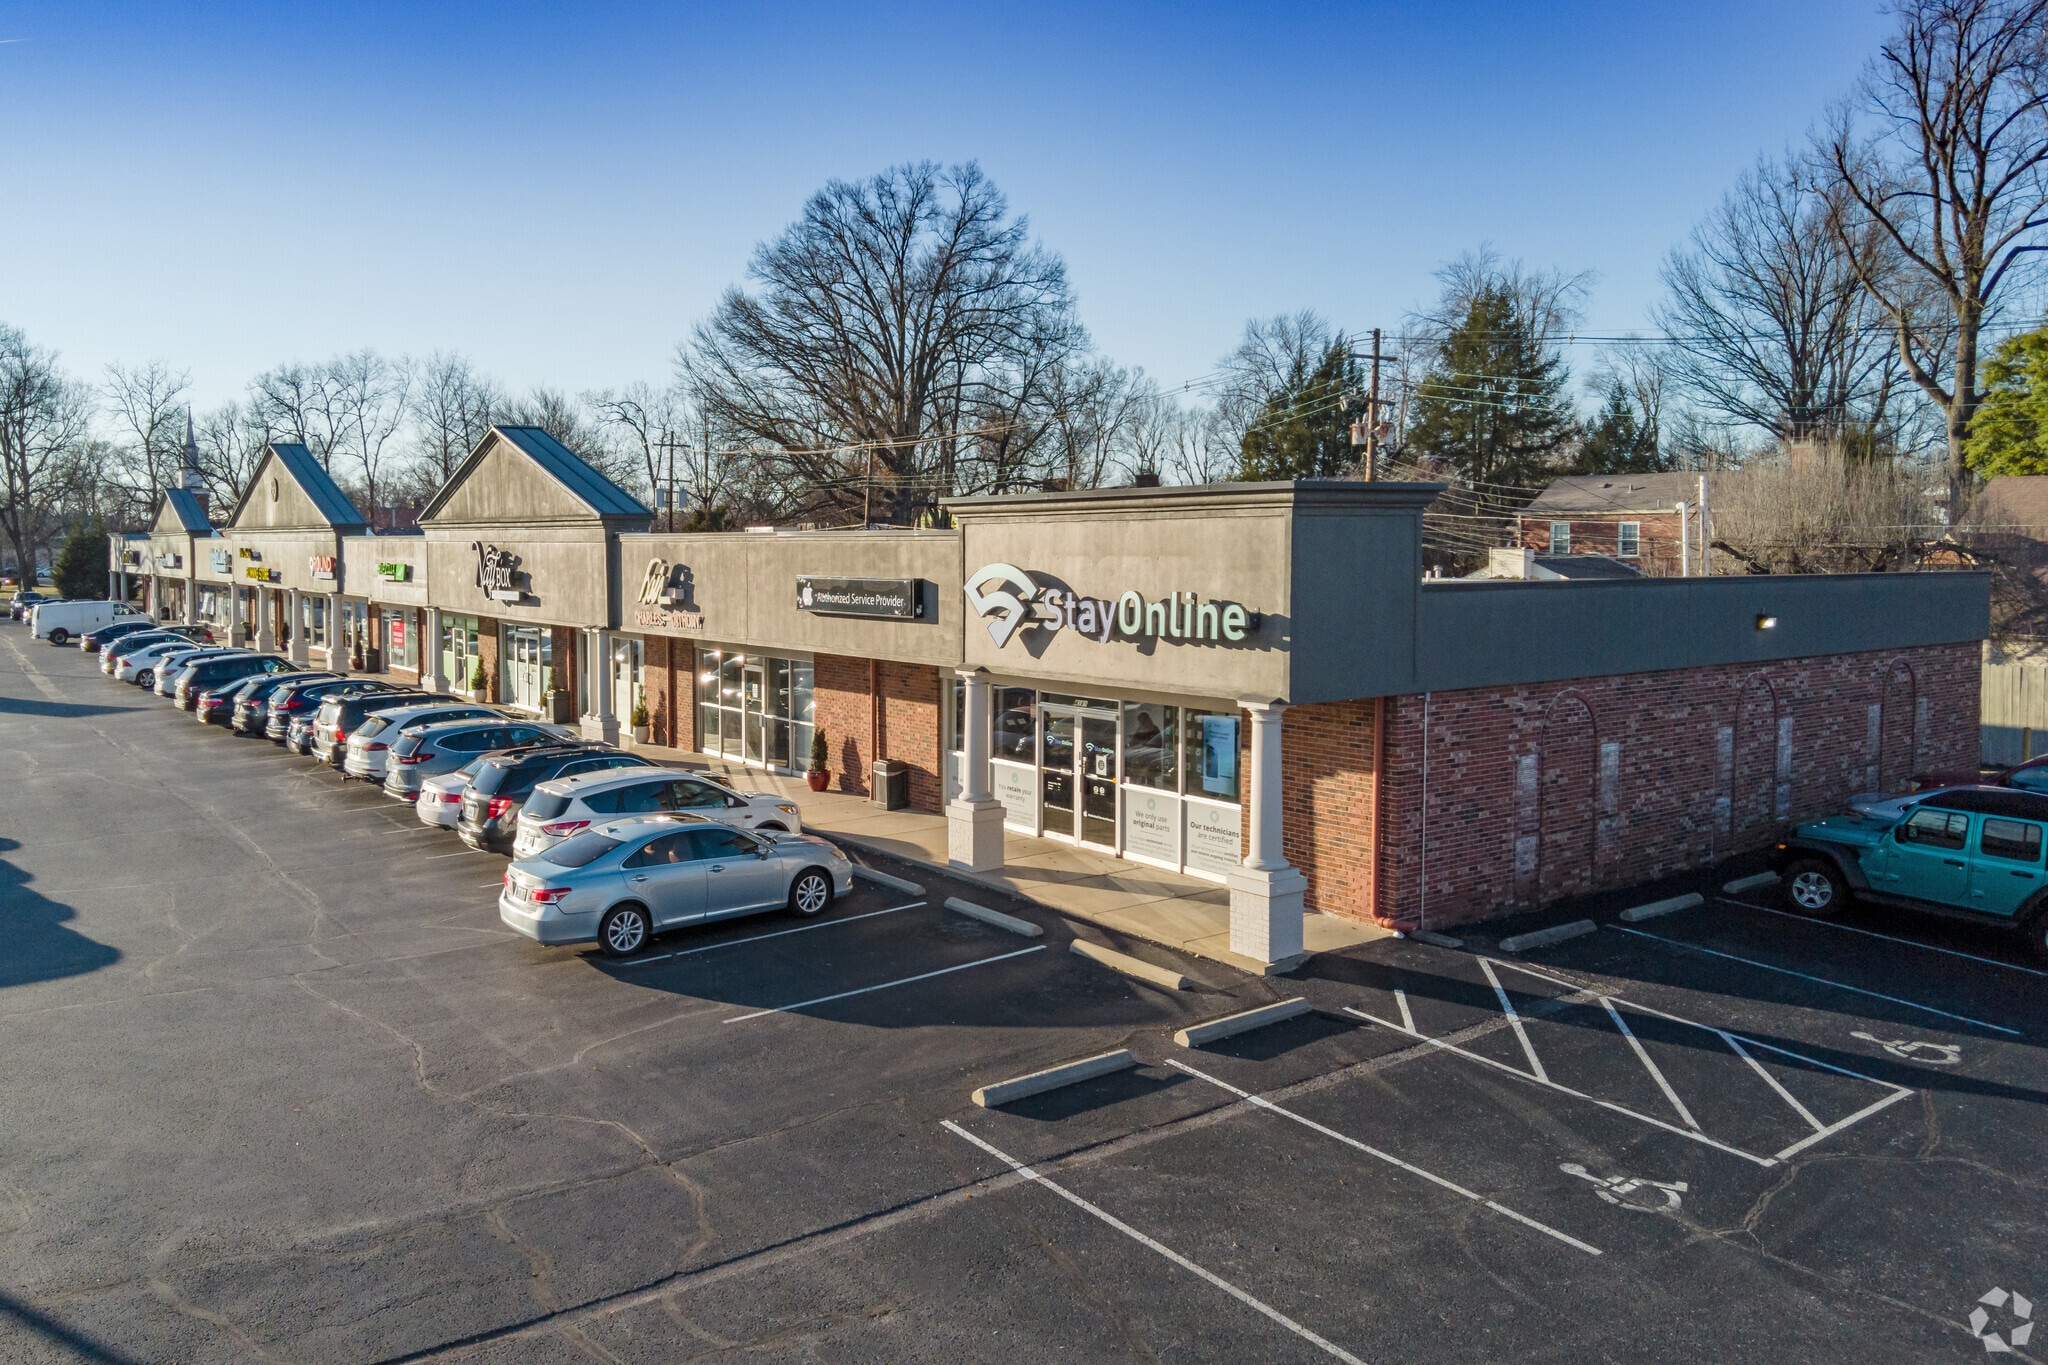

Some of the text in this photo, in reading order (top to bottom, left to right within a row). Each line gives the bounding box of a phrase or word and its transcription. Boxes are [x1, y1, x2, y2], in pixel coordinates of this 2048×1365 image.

[496, 567, 511, 588] BOX
[816, 591, 904, 607] Authorized Service Provider
[1042, 587, 1248, 645] StayOnline
[1005, 794, 1026, 803] warranty
[1135, 810, 1168, 823] We only use
[1132, 819, 1171, 833] original parts
[1190, 821, 1240, 838] Our technicians
[1197, 832, 1234, 846] are certified
